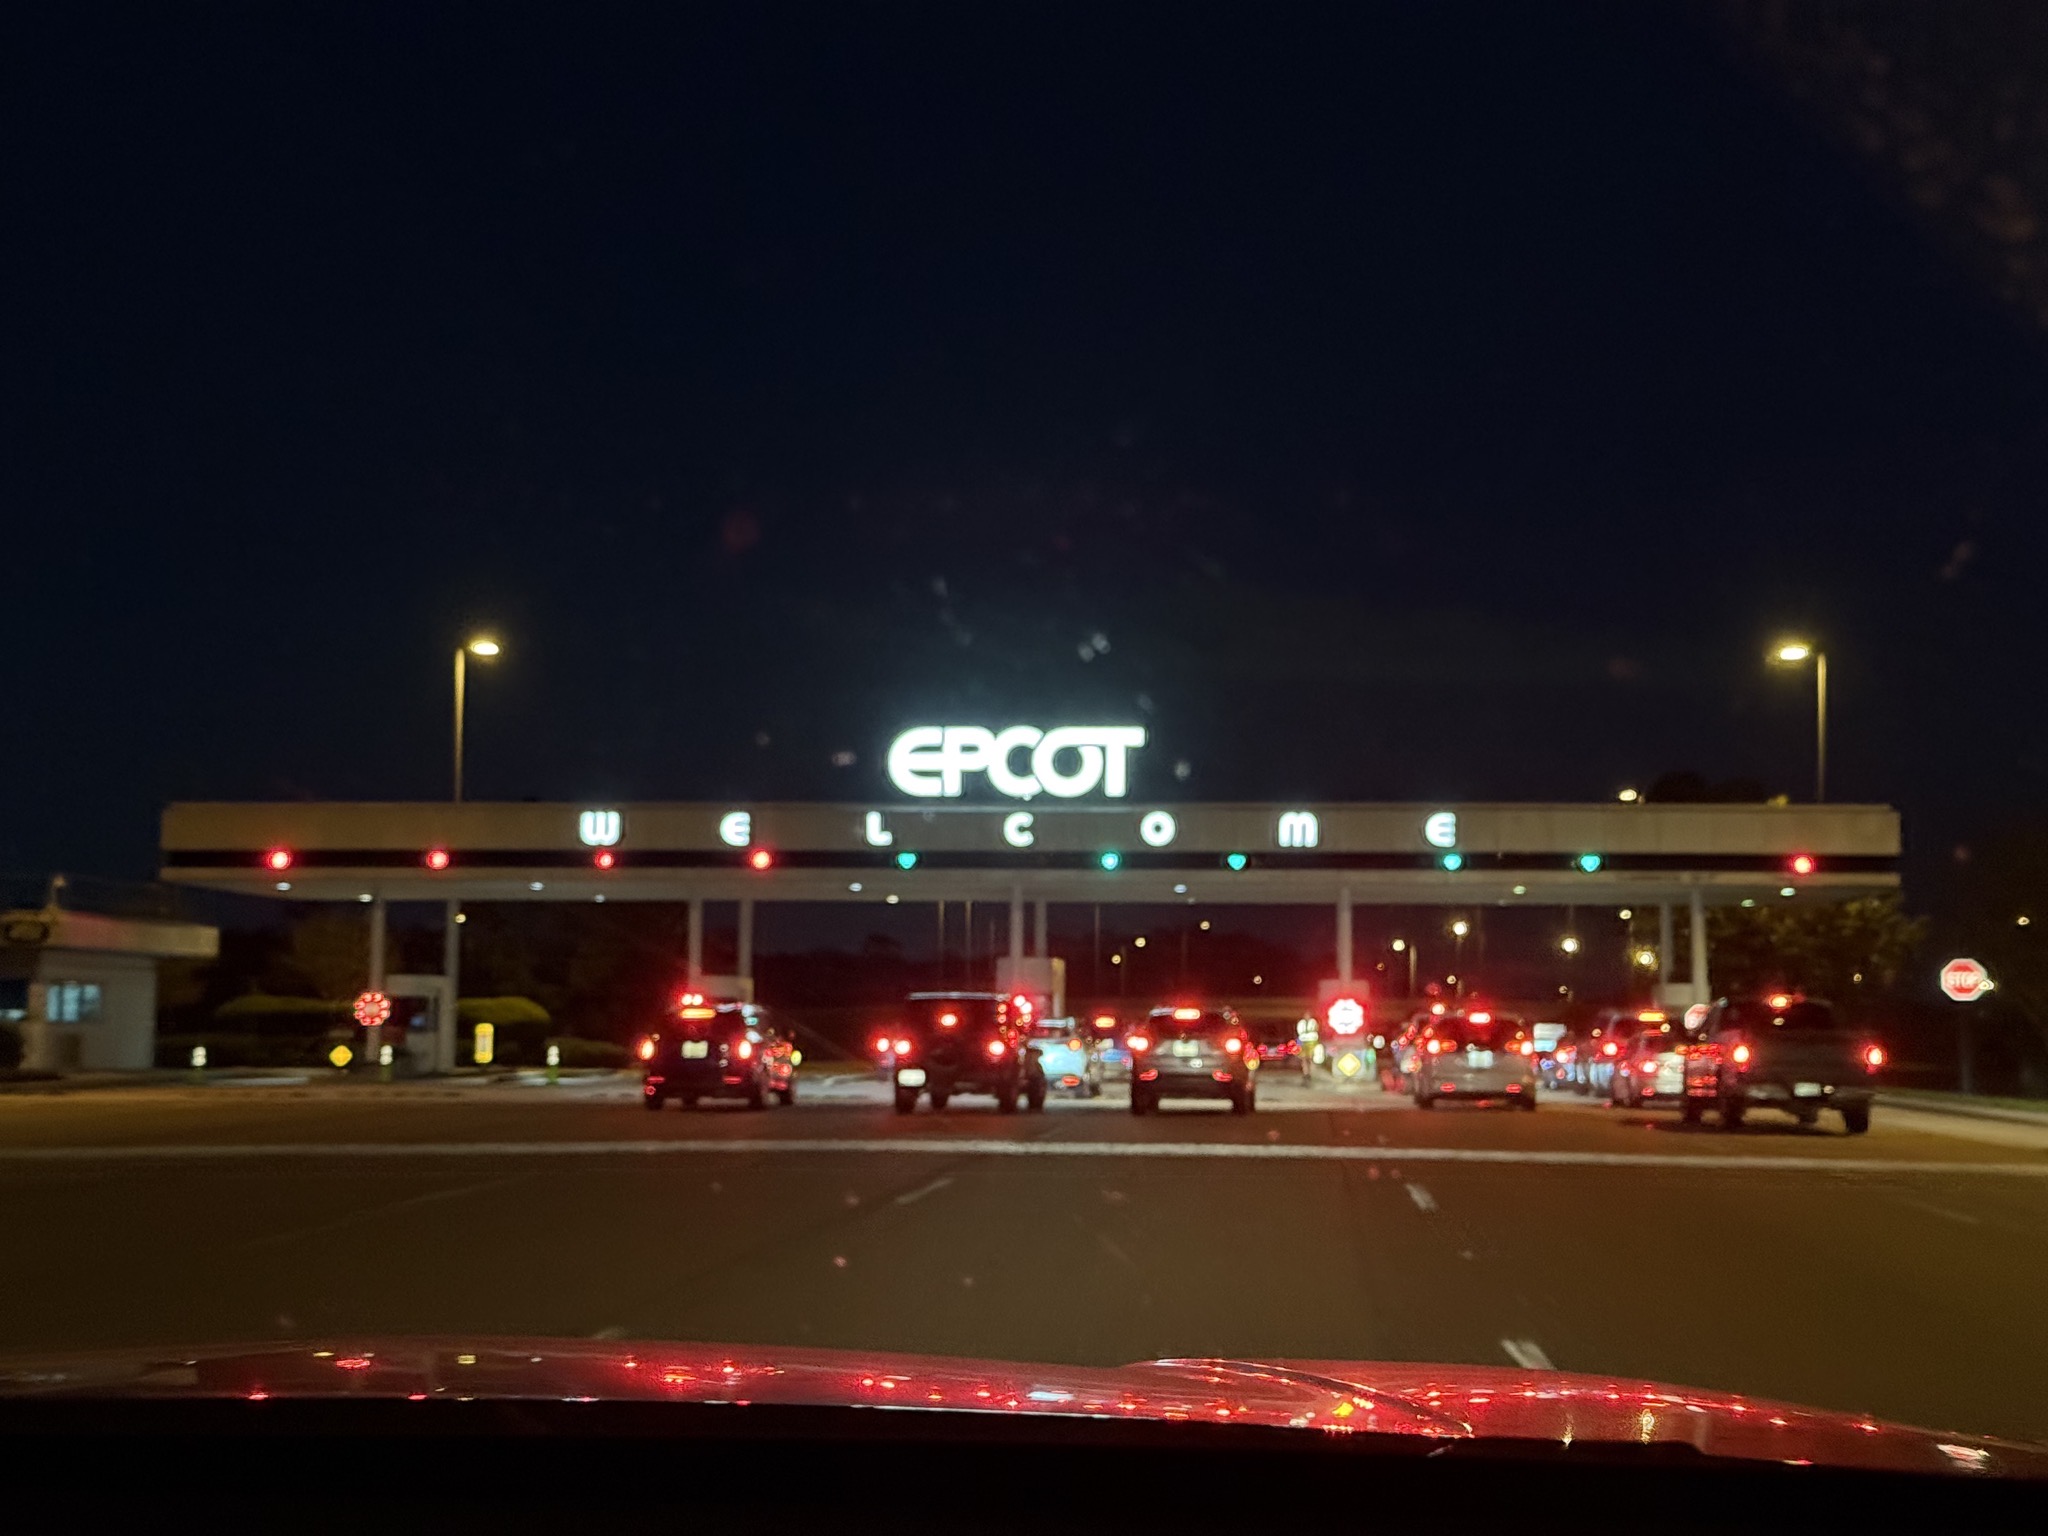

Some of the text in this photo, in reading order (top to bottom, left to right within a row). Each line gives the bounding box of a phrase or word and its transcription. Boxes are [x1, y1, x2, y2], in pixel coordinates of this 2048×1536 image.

[887, 725, 1146, 798] EPCOT
[578, 810, 1456, 847] WELCOME
[1946, 971, 1981, 987] STOP
